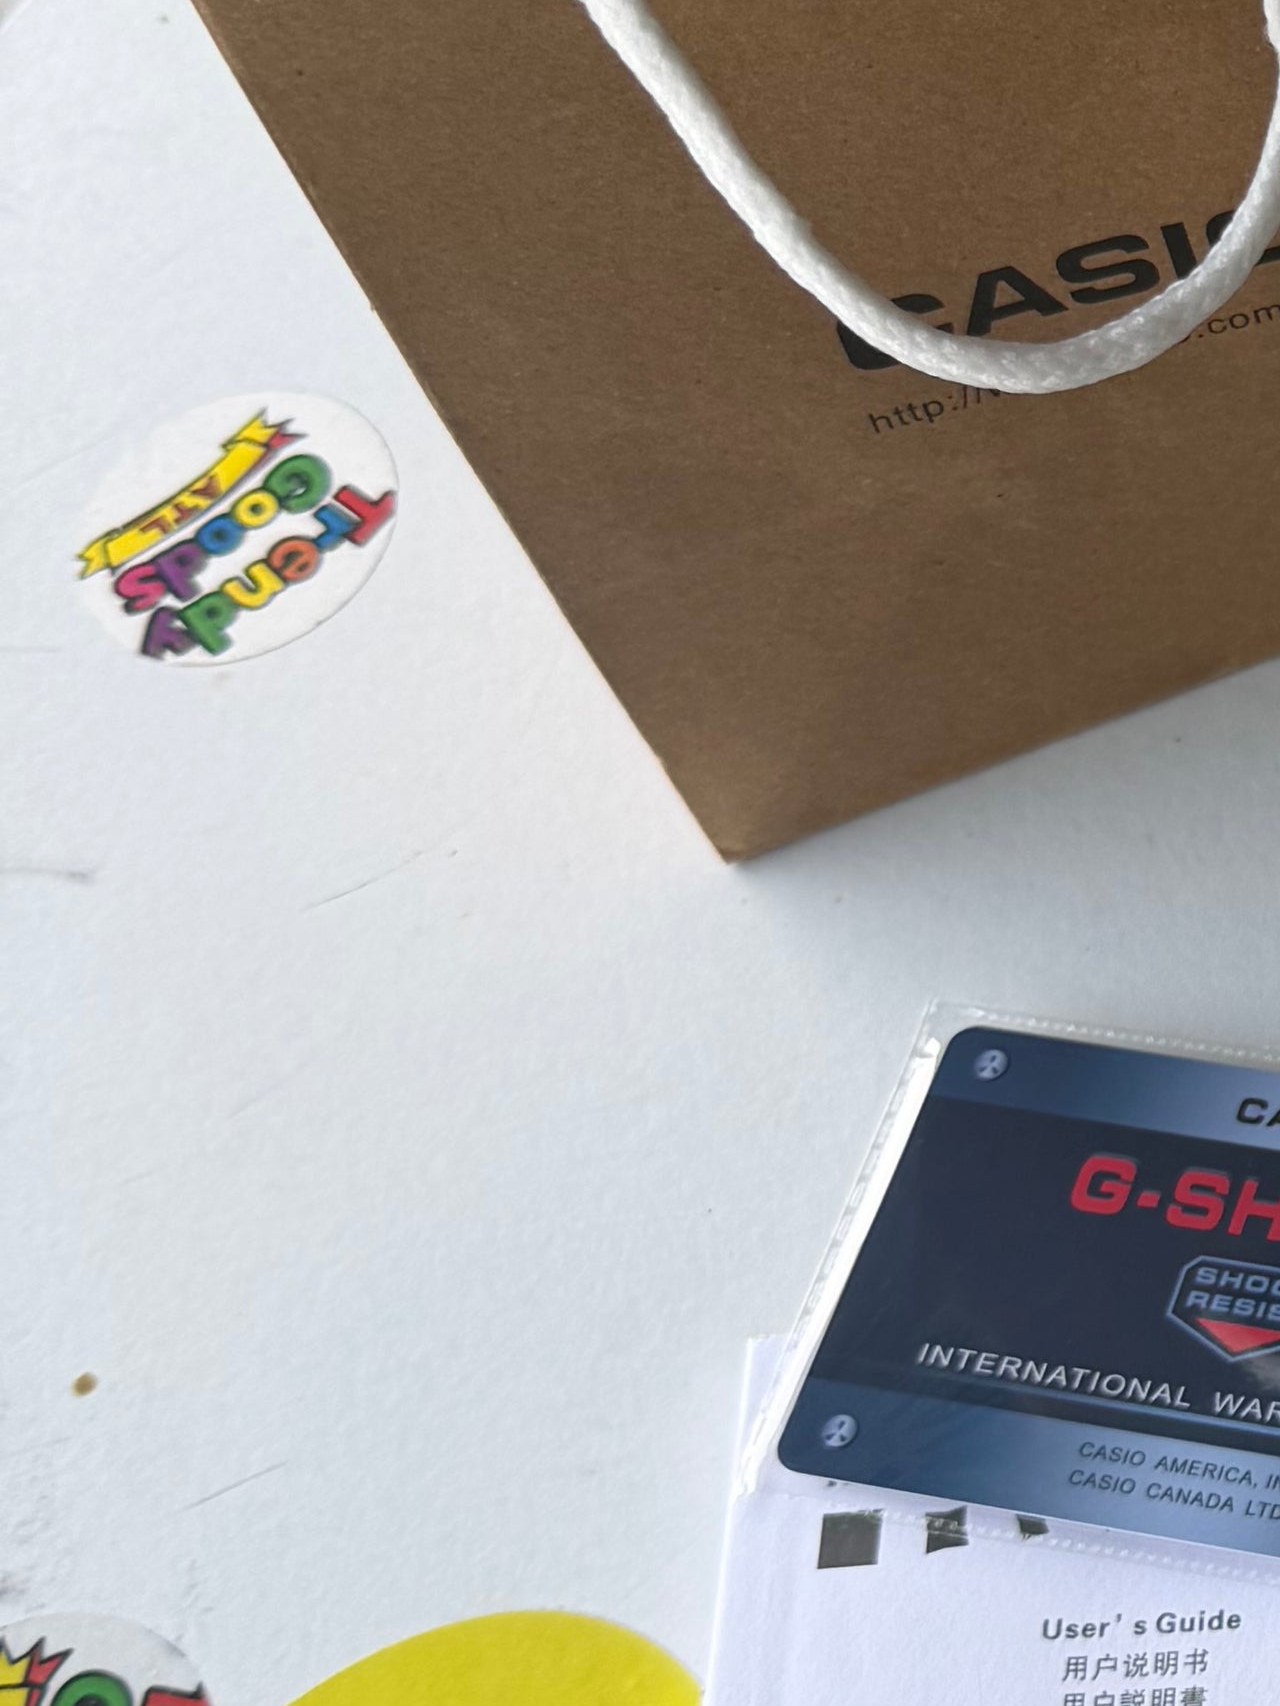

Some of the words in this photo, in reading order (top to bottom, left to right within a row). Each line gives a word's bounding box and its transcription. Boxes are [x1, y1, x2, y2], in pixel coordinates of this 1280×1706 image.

[139, 473, 222, 536] ATL
[112, 453, 332, 614] Goods
[140, 483, 398, 660] Trendy
[916, 1342, 1192, 1407] INTERNATIONAL
[1068, 1469, 1136, 1495] CASIO
[1146, 1482, 1234, 1513] CANADA
[1078, 1441, 1147, 1467] CASIO
[1154, 1455, 1258, 1489] AMERICA,
[1155, 1608, 1243, 1635] Guide
[1061, 1647, 1209, 1683] 用户说明书
